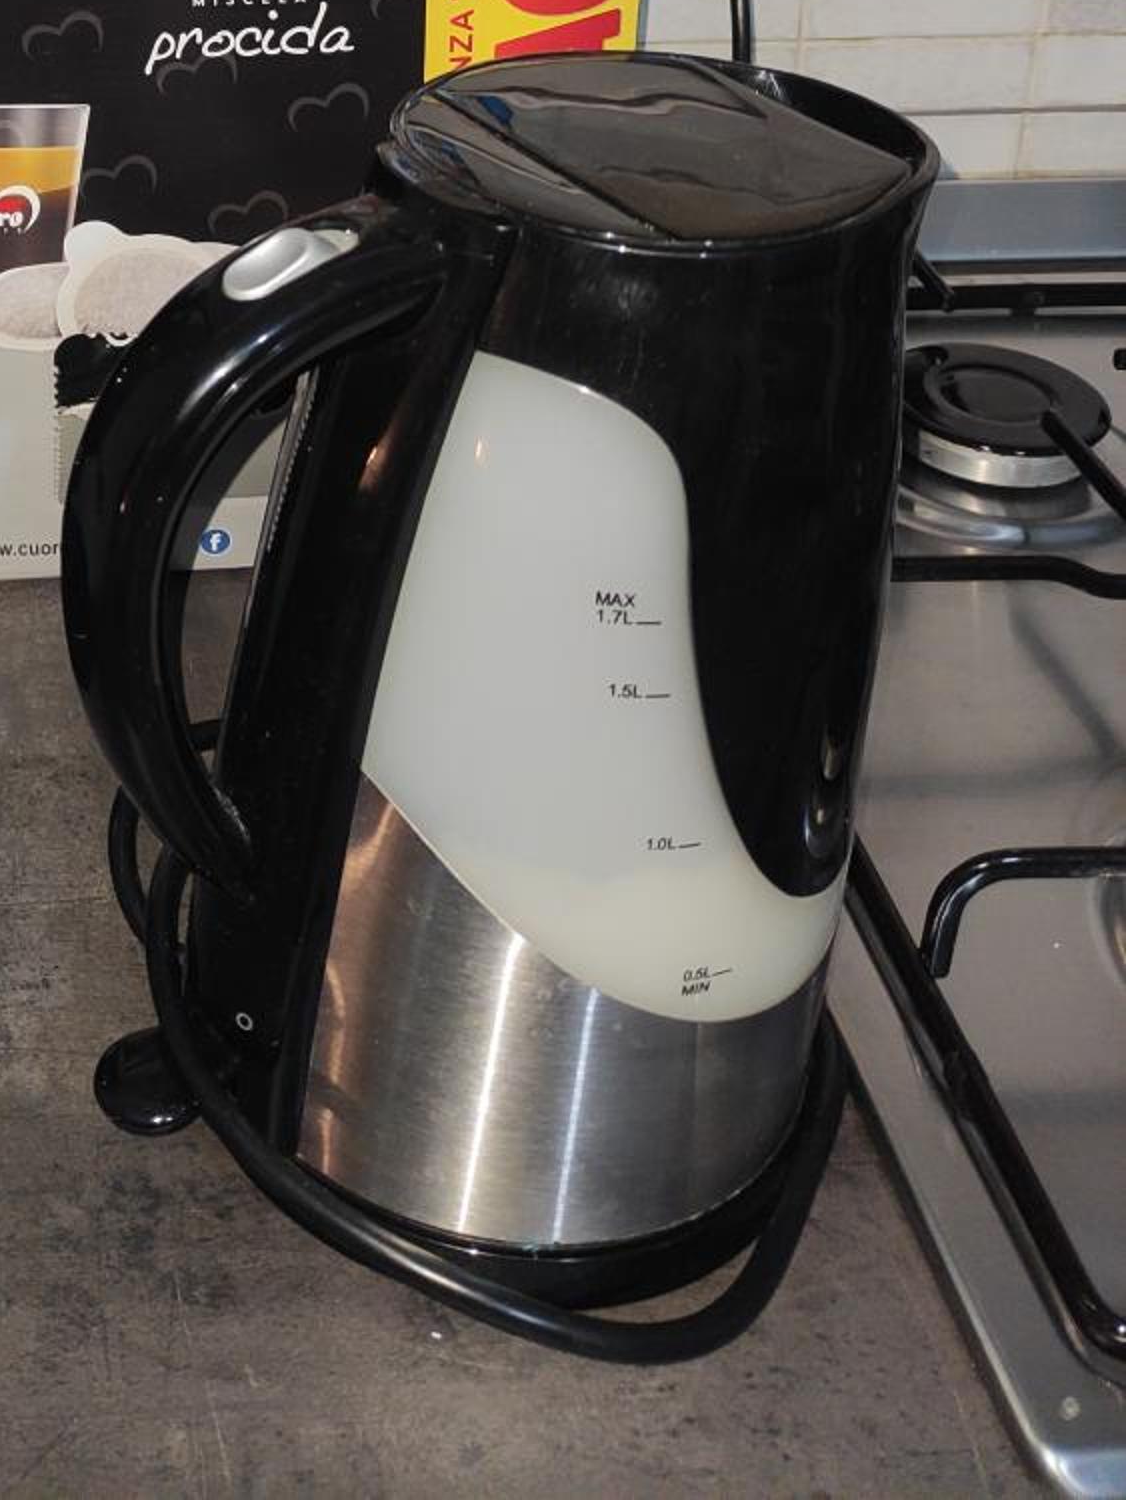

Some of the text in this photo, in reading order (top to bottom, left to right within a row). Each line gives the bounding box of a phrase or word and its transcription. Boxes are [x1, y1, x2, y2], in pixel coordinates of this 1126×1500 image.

[143, 1, 356, 76] procida
[595, 590, 636, 608] MAX
[597, 609, 633, 626] 1.7L
[608, 683, 642, 699] 1.5L
[646, 837, 675, 851] 1.0L
[681, 981, 711, 997] MIN
